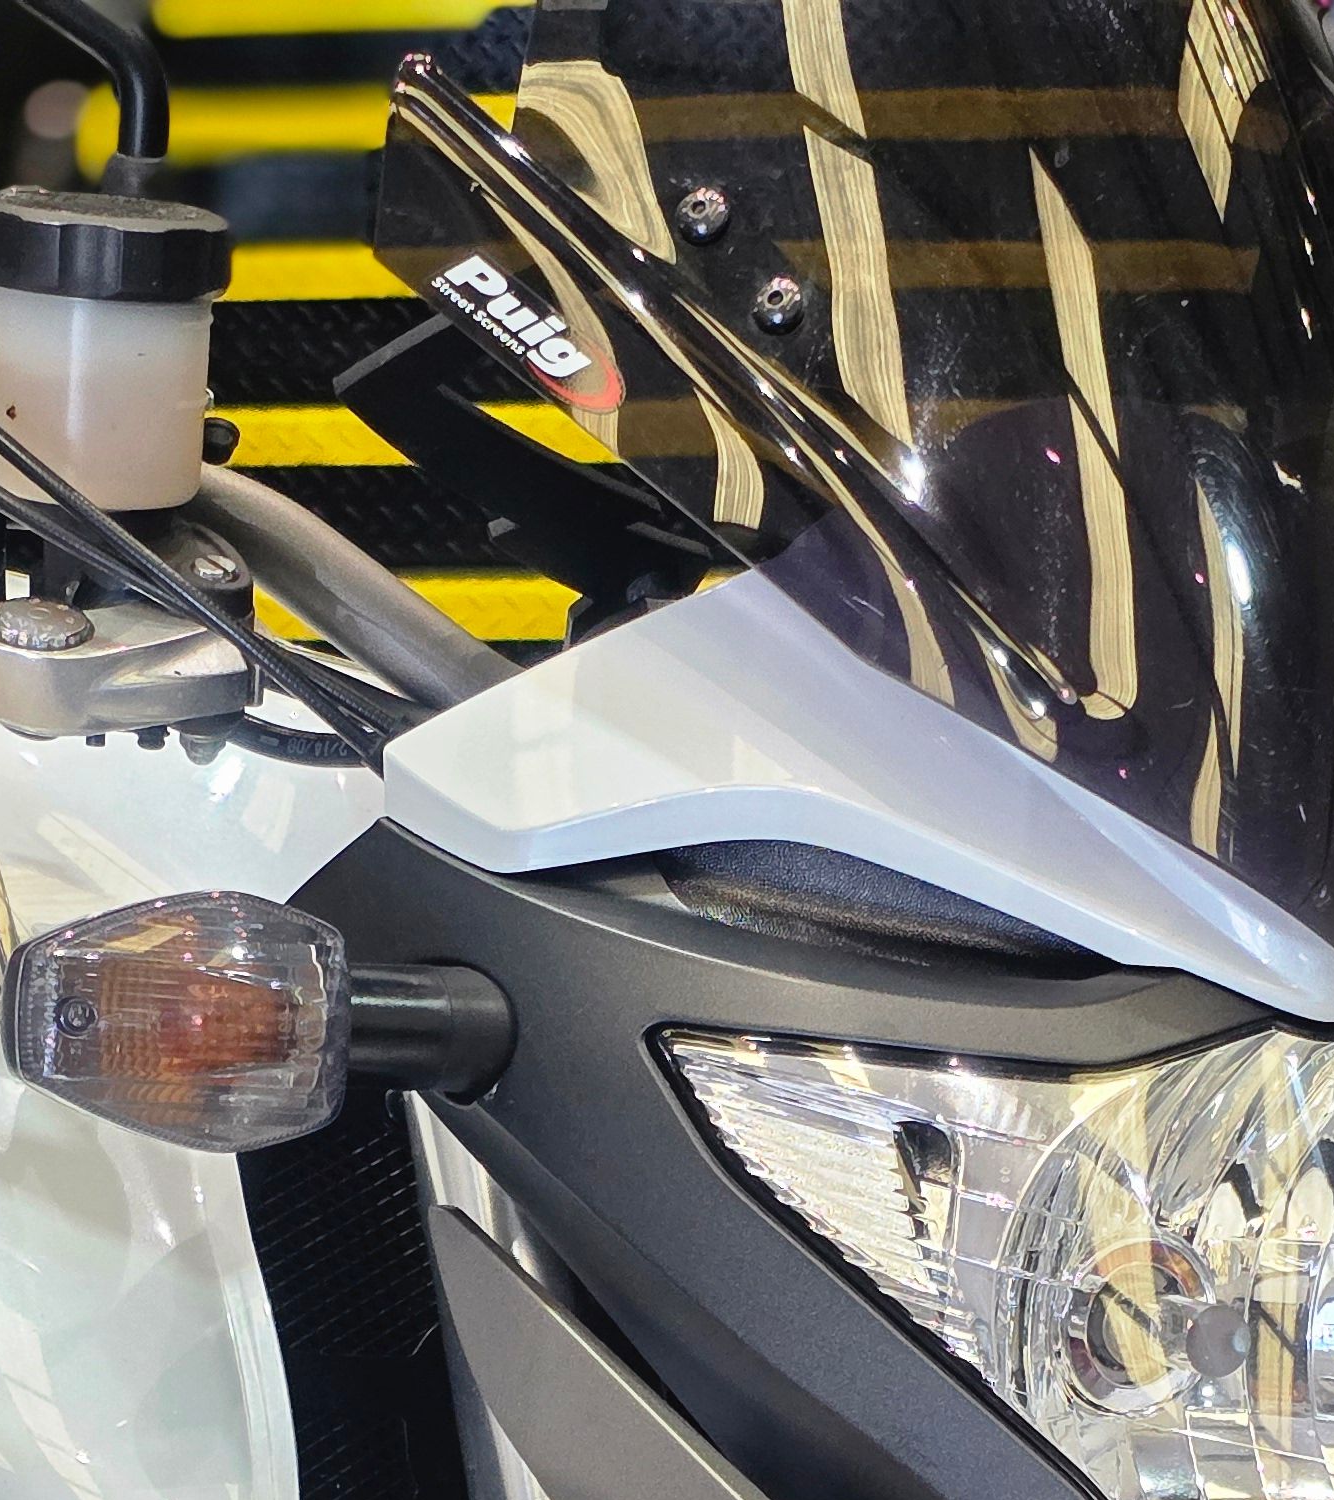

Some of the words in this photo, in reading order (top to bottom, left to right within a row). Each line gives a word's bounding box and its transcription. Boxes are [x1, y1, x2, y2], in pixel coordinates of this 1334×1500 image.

[431, 276, 475, 314] Street
[473, 310, 526, 355] Screens
[443, 255, 592, 378] Puig
